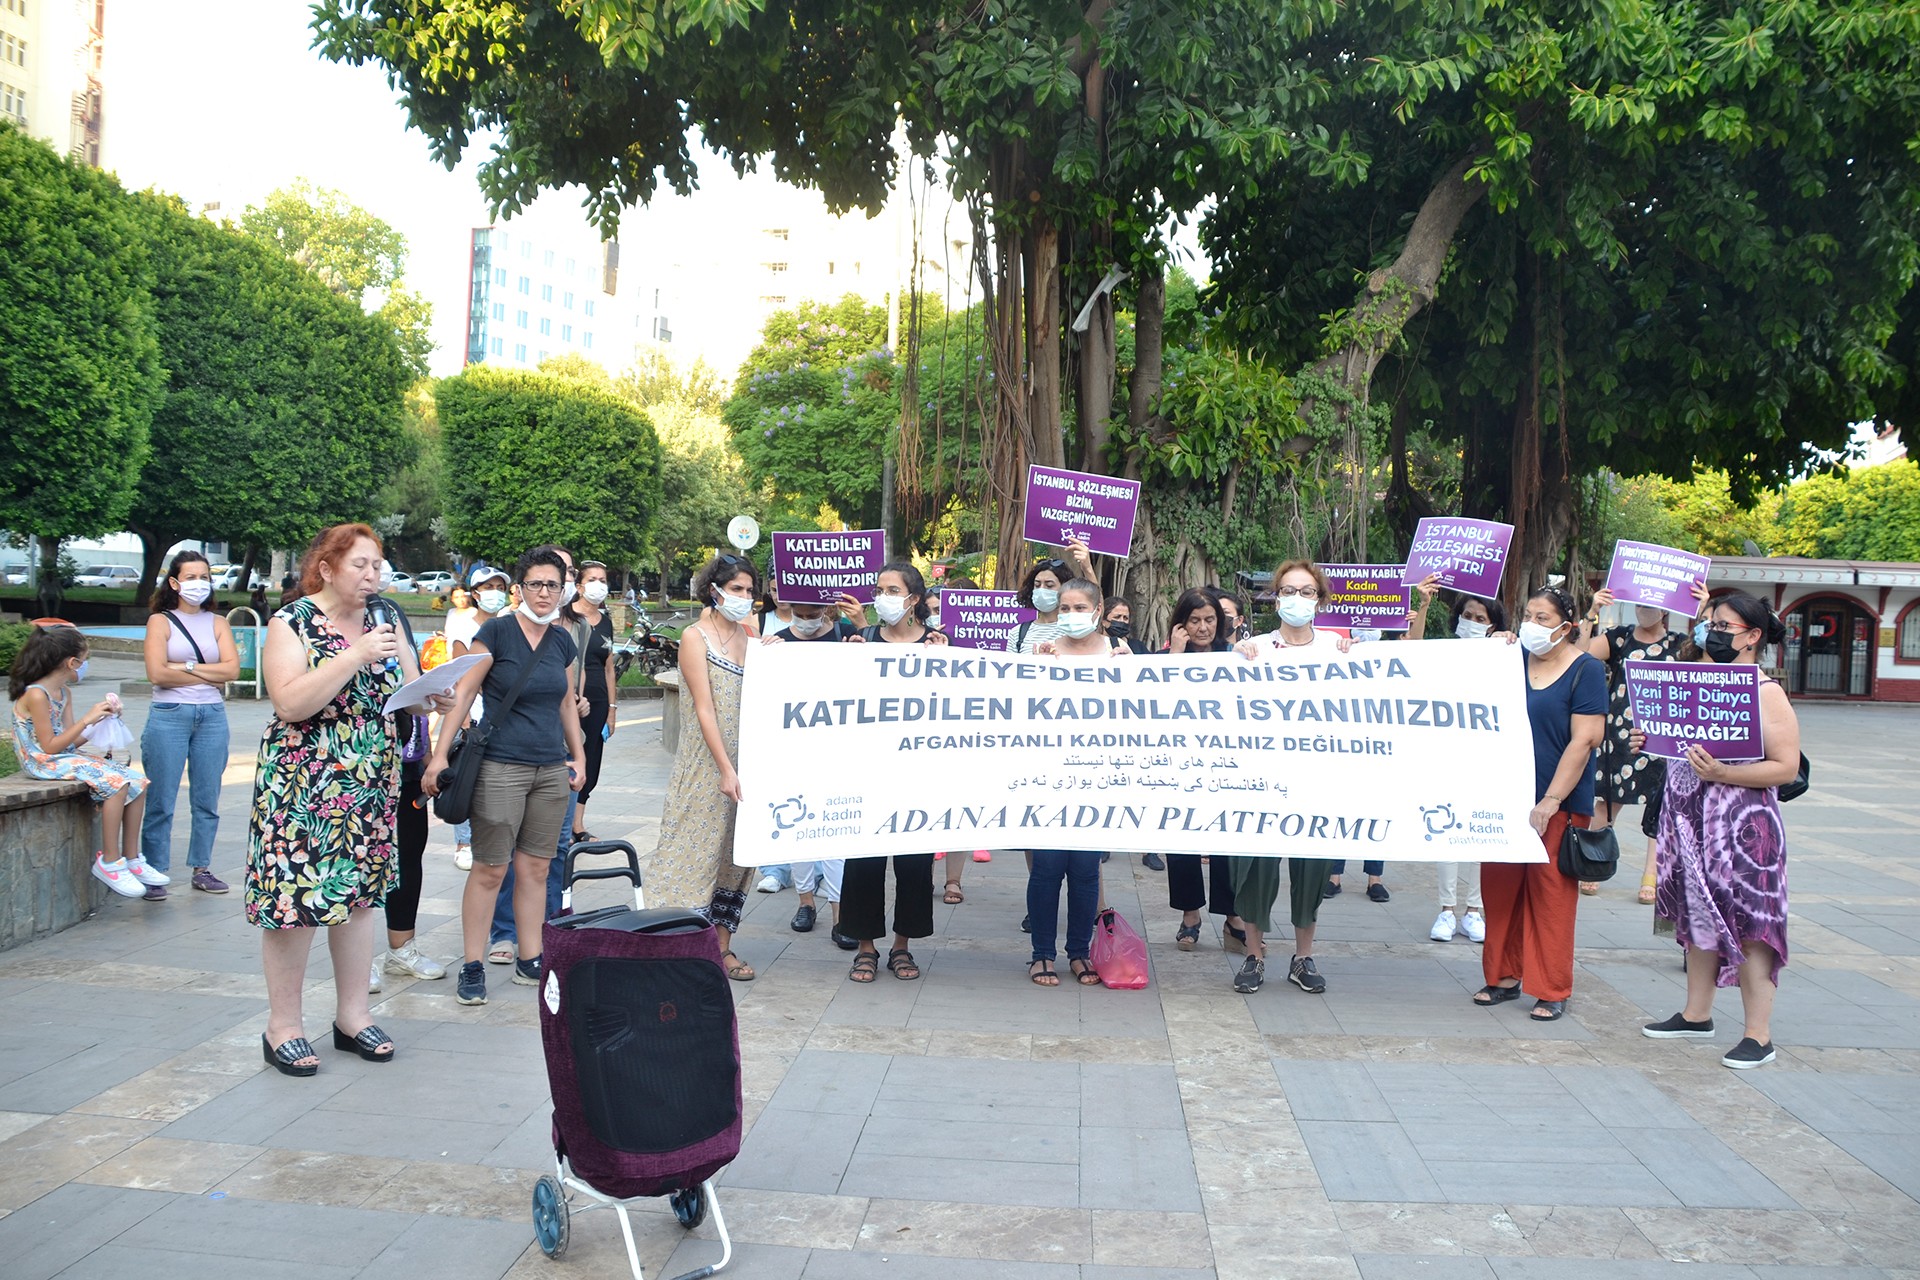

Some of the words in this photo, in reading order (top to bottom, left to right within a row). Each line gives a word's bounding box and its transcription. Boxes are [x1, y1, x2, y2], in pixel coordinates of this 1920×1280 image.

[1034, 472, 1075, 491] İSTANBUL
[1077, 480, 1134, 500] SÖZLEŞMESİ
[1066, 494, 1093, 511] BİZİM,
[1041, 507, 1117, 529] VAZGEÇMİYORUZ!
[1425, 523, 1495, 543] İSTANBUL
[786, 536, 871, 552] KATLEDİLEN
[1414, 538, 1503, 562] SÖZLEŞMESİ
[794, 556, 865, 569] KADINLAR
[1419, 556, 1484, 576] YAŞATIR!
[782, 570, 878, 587] İSYANIMIZDIR!
[1346, 580, 1378, 590] Kadın
[948, 593, 991, 607] ÖLMEK
[1330, 593, 1401, 604] ayanışmasını
[960, 611, 1018, 625] YAŞAMAK
[874, 654, 1121, 683] TÜRKİYE'DEN
[1136, 658, 1411, 683] AFGANİSTAN'A
[1630, 669, 1674, 684] DAYANIŞMA
[1676, 671, 1688, 683] VE
[1690, 671, 1753, 687] KARDEŞLİKTE
[1633, 684, 1662, 698] Yeni
[1669, 686, 1691, 701] Bir
[1699, 688, 1751, 708] Dünya
[783, 692, 1012, 729] KATLEDİLEN
[1028, 697, 1224, 720] KADINLAR
[1236, 695, 1500, 732] İSYANIMIZDIR!
[1636, 700, 1662, 718] Eşit
[1669, 703, 1690, 718] Bir
[1698, 705, 1750, 725] Dünya
[1640, 719, 1750, 740] KURACAĞIZ!
[898, 732, 1062, 751] AFGANİSTANLI
[1070, 734, 1186, 748] KADINLAR
[1195, 734, 1275, 750] YALNIZ
[1283, 735, 1392, 755] DEĞİLDİR!
[1109, 755, 1134, 769] تنها
[1140, 754, 1172, 769] افغان
[1210, 756, 1238, 772] خانم
[1032, 775, 1046, 786] نه
[1097, 773, 1130, 789] افغان
[1208, 778, 1268, 792] افغانستان
[826, 796, 862, 806] adana
[823, 809, 861, 821] kadın
[1472, 810, 1504, 820] adana
[874, 805, 1007, 834] ADANA
[1019, 805, 1147, 829] KADIN
[1157, 806, 1392, 842] PLATFORMU
[1470, 822, 1504, 834] kadın
[796, 825, 861, 842] platformu
